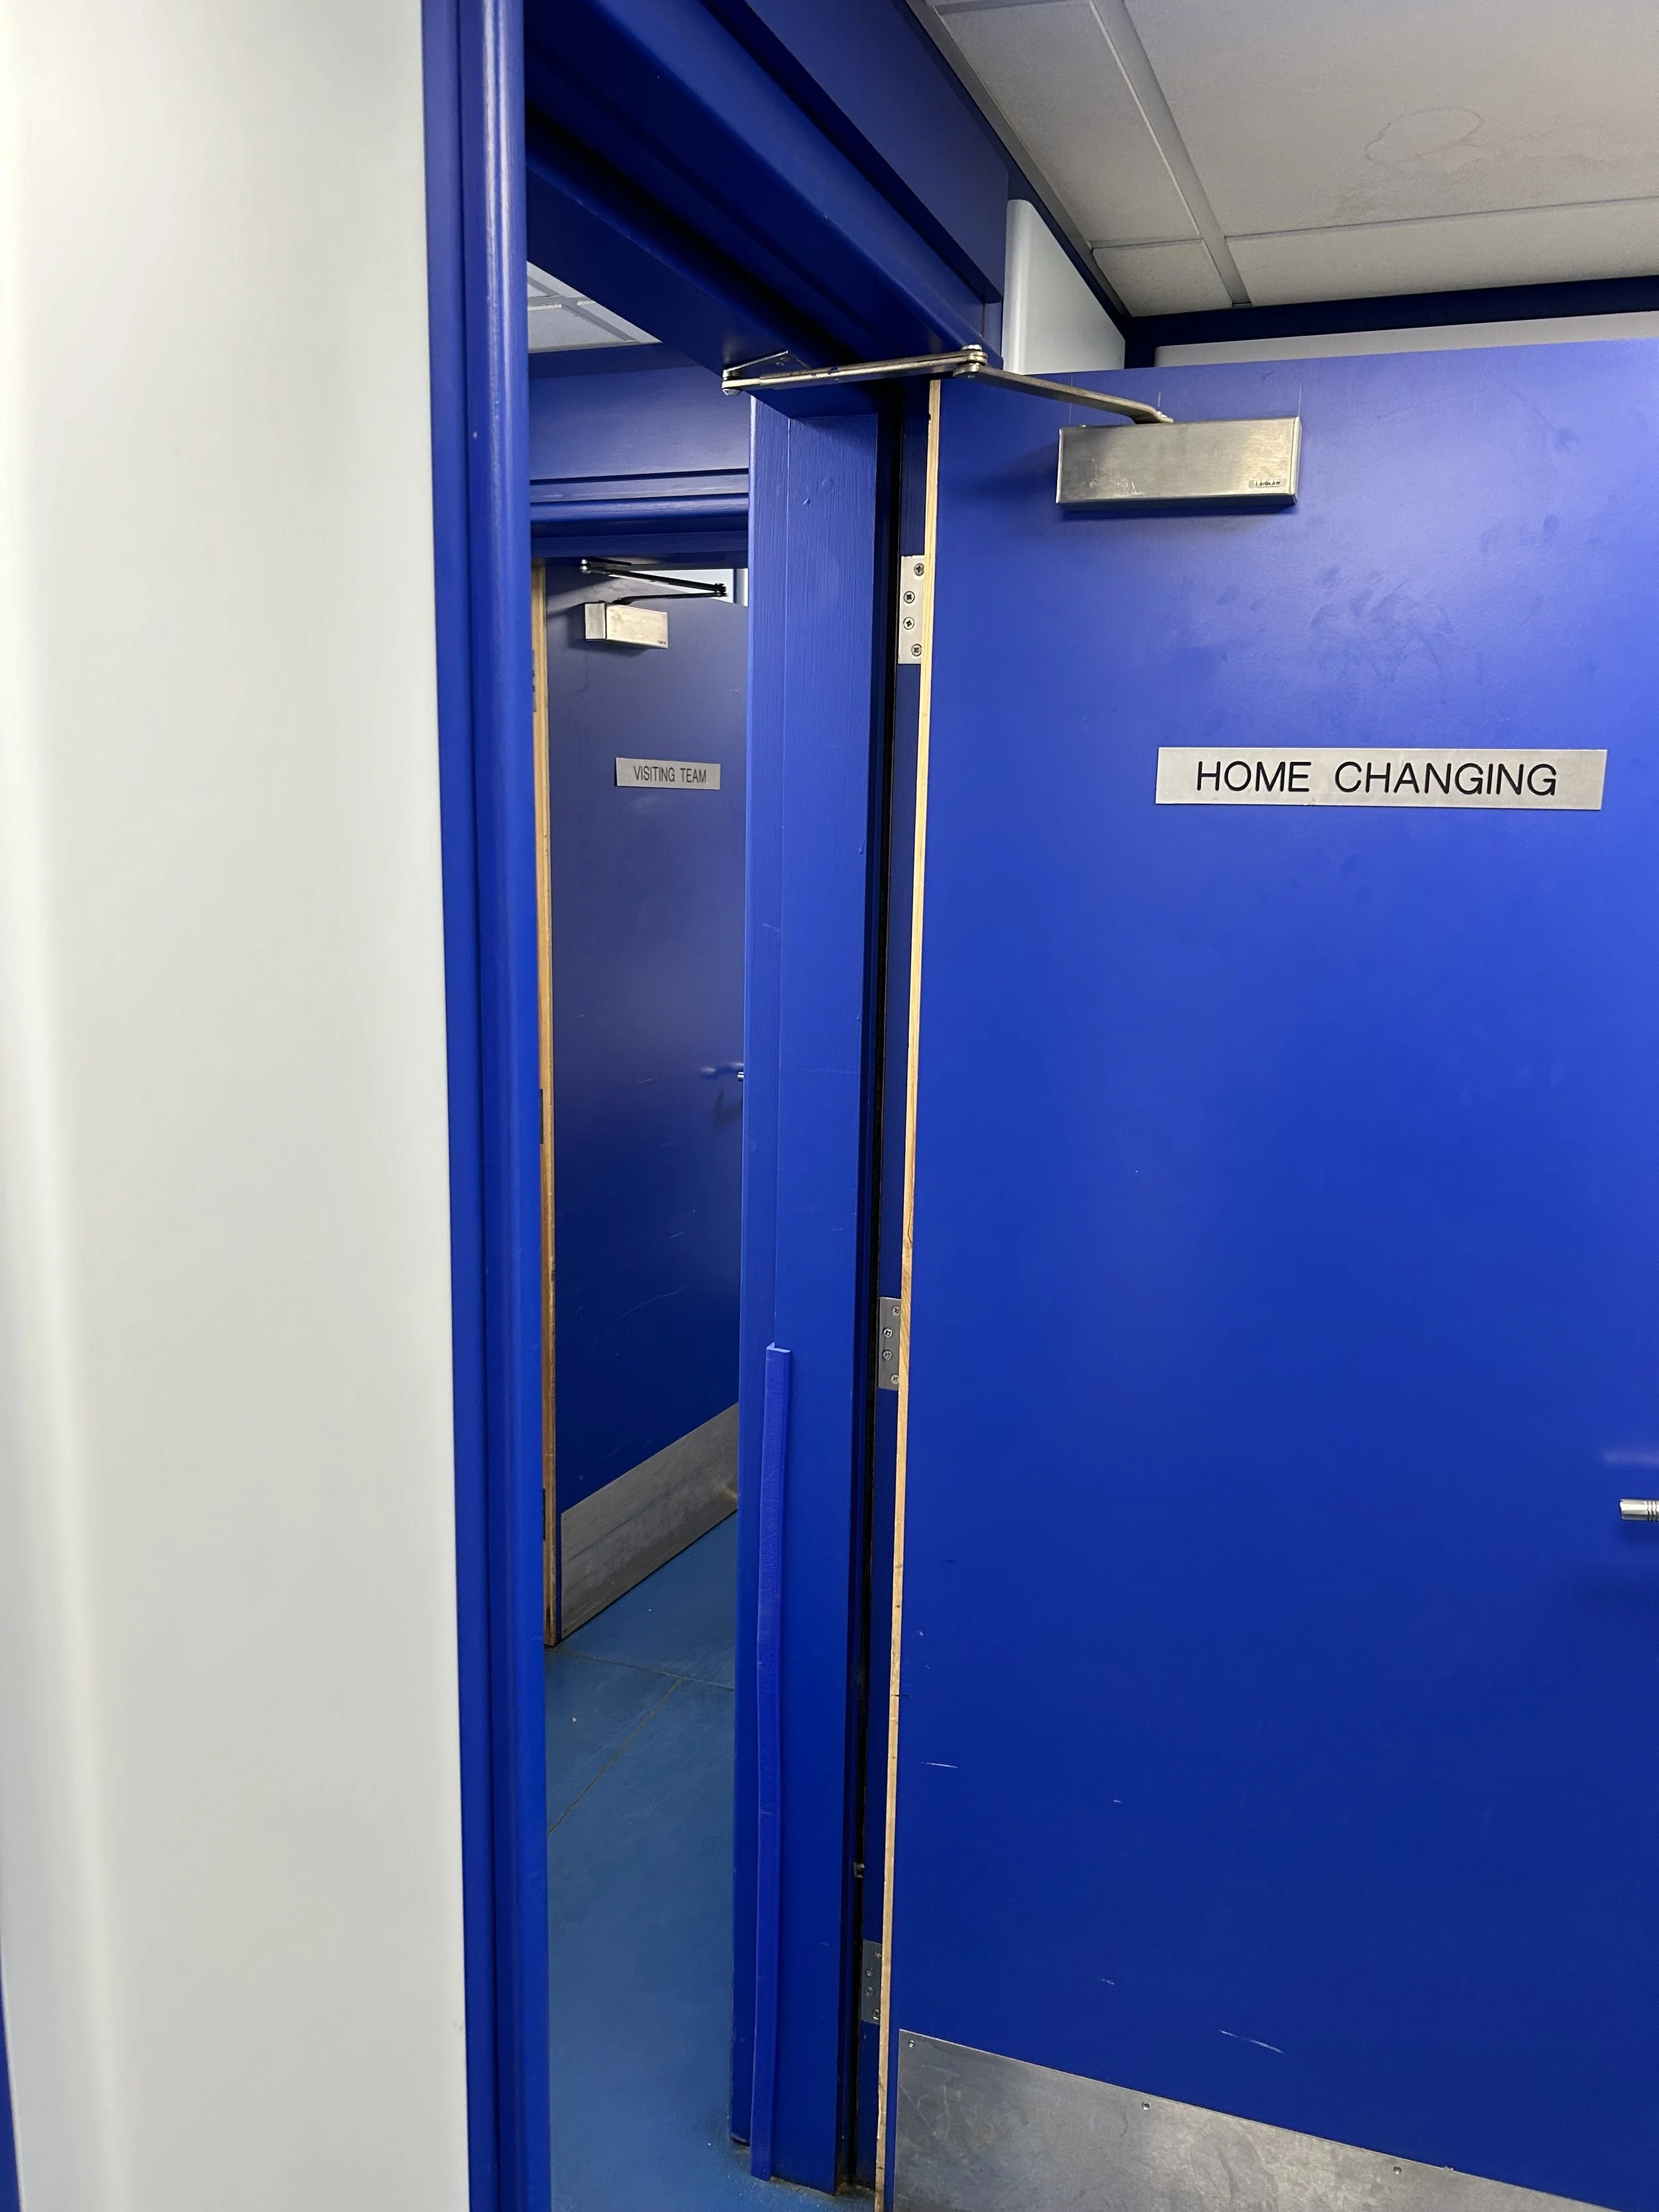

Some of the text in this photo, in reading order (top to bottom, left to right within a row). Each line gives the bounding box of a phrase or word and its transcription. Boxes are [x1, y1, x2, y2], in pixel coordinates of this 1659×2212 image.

[633, 765, 707, 783] VISITING TEAM
[1196, 761, 1557, 796] HOME CHANGING
